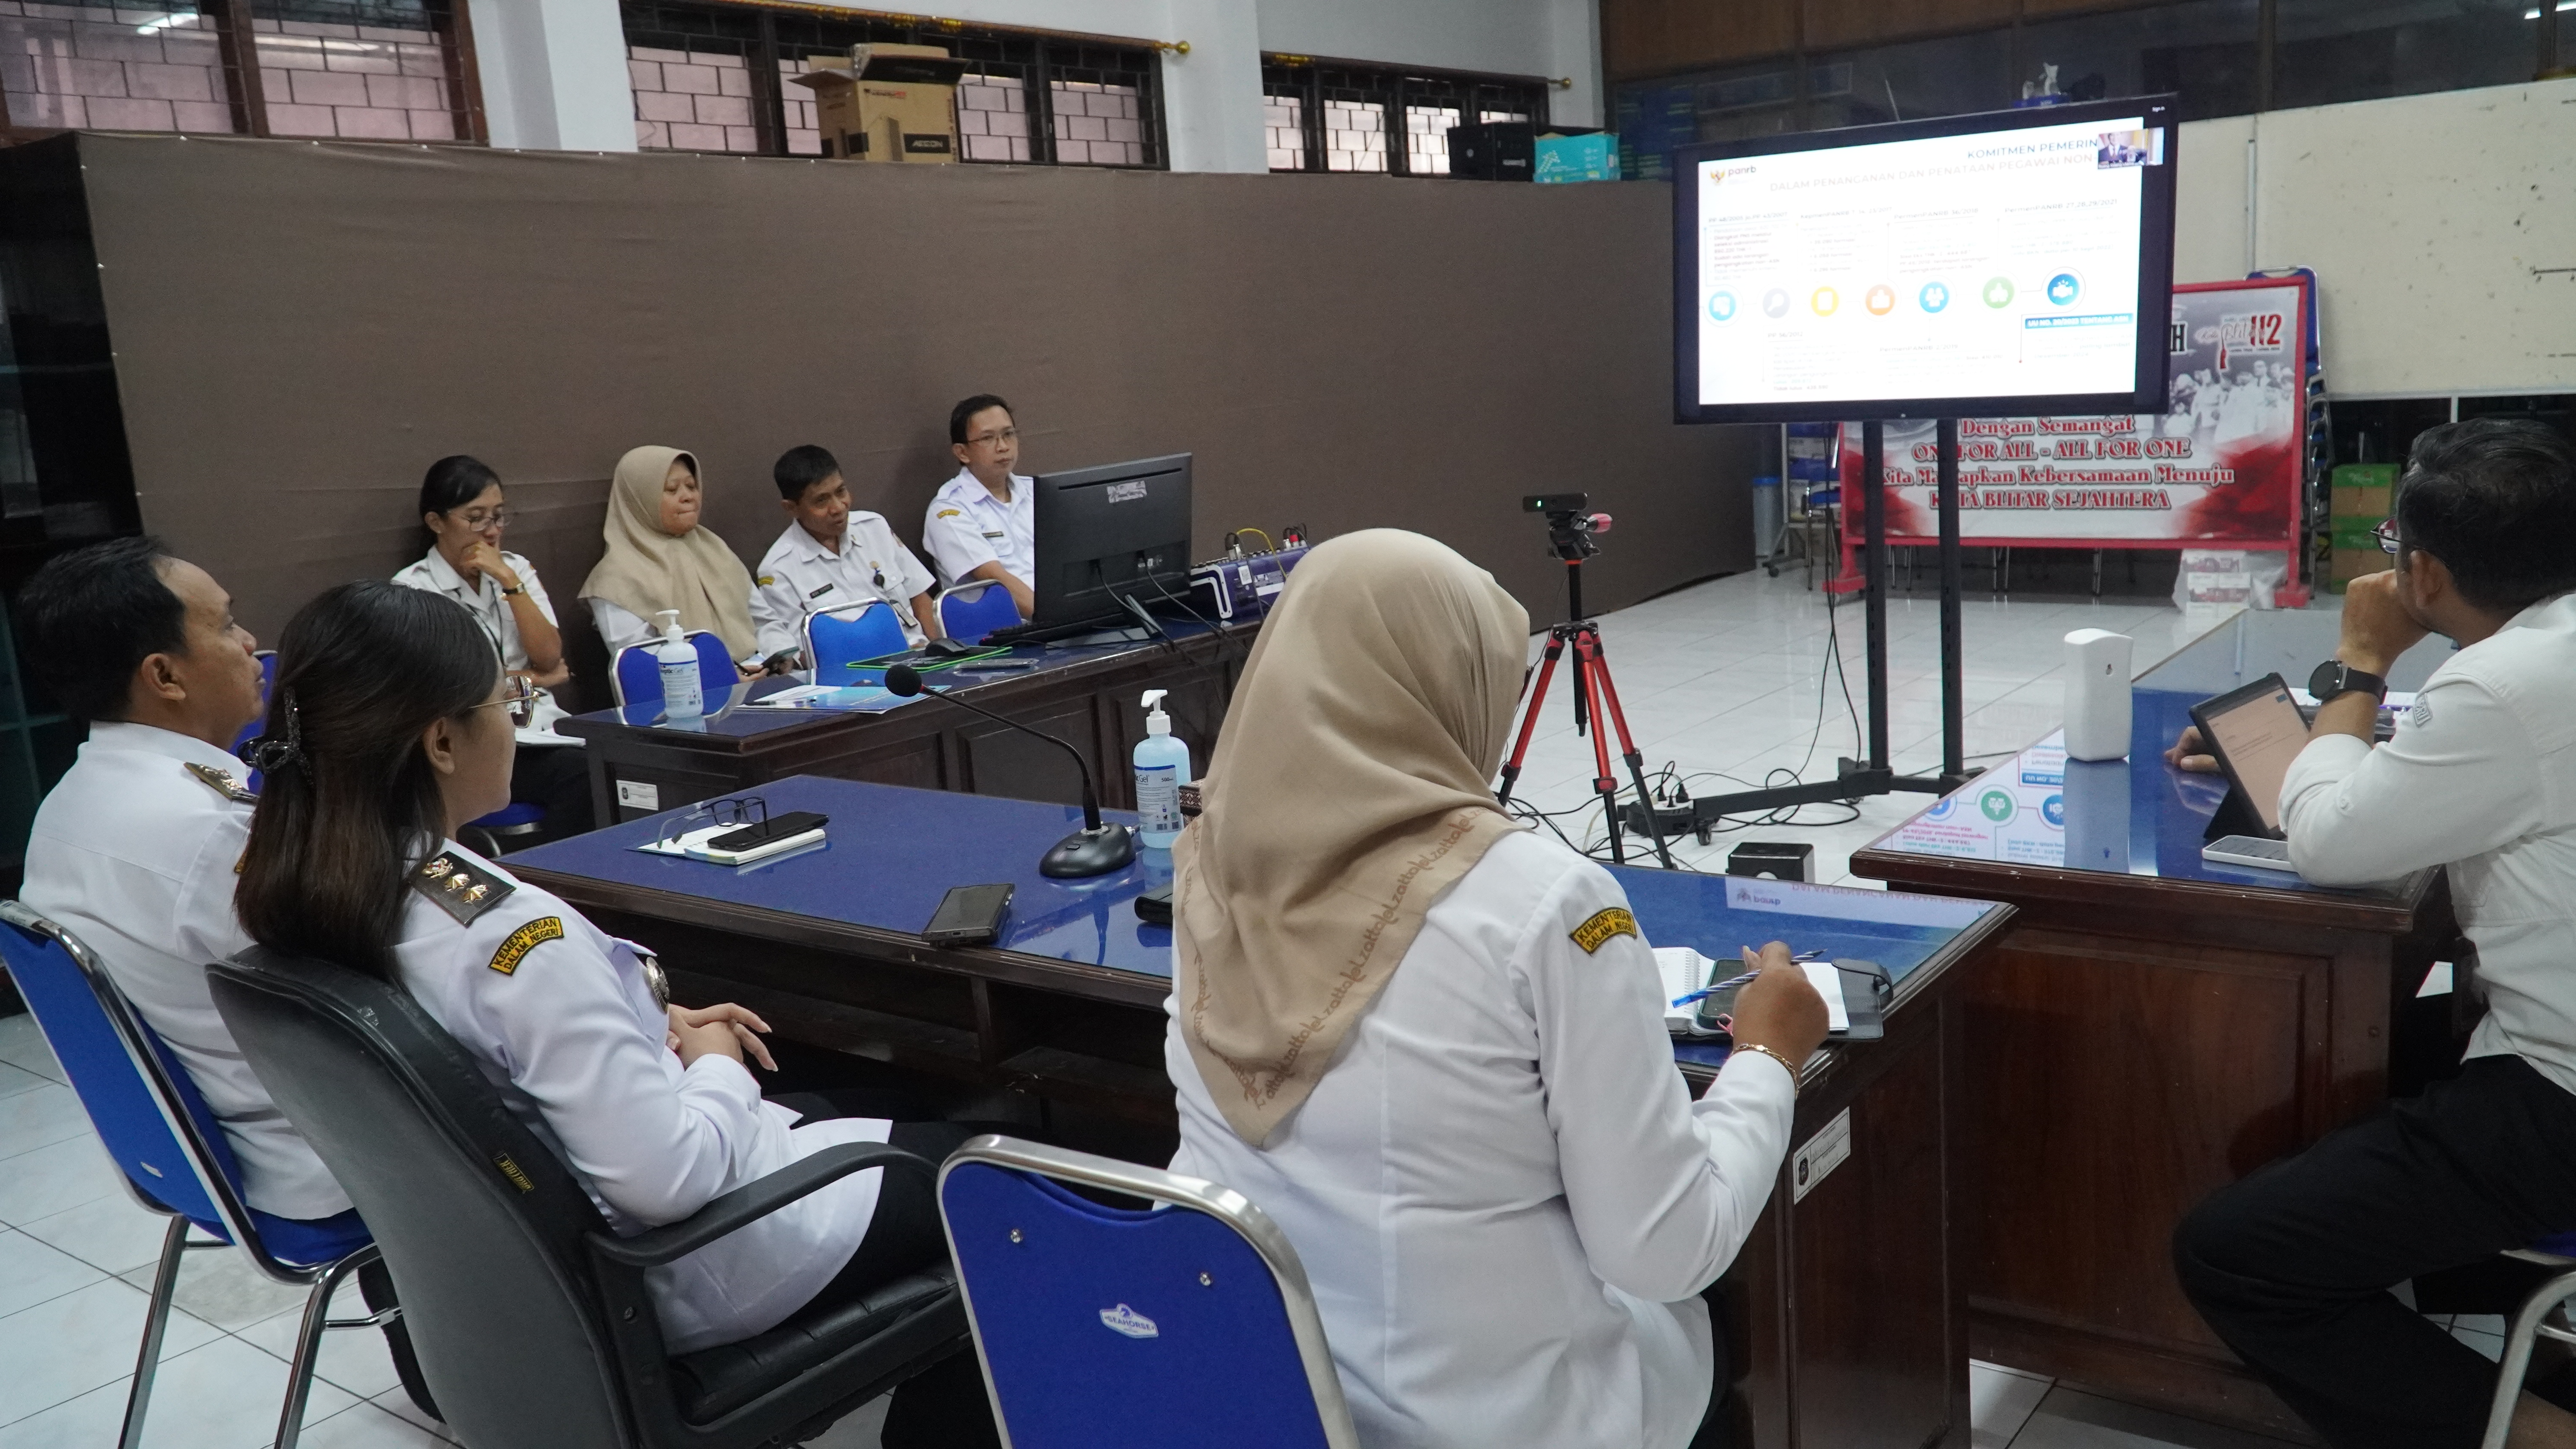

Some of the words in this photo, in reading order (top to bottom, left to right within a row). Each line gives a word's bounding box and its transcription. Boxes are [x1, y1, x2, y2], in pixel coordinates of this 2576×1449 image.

[1968, 145, 2035, 159] KOMITMEN
[2040, 139, 2097, 153] PEMERIN
[1728, 165, 1756, 176] panrb
[1770, 180, 1810, 192] DALAM
[1814, 172, 1895, 188] PENANGANAN
[1899, 168, 1924, 180] DAN
[1929, 163, 1995, 177] PENATAAN
[1999, 158, 2060, 170] PEGAWAI
[1894, 210, 1948, 219] PermenPANRB
[2005, 203, 2063, 212] PermenPANRB
[1961, 418, 2034, 439] Dengan
[2038, 414, 2135, 437] Semangat
[2001, 440, 2038, 460] ALL
[2054, 439, 2093, 459] ALL
[2095, 438, 2142, 459] FOR
[2145, 437, 2192, 458] ONE
[2018, 465, 2151, 485] Kebersamaan
[2154, 463, 2235, 487] Menuju
[1984, 489, 2050, 509] BLITAR
[2052, 489, 2172, 509] SEJAHTERA
[1139, 774, 1148, 783] Gel
[1577, 909, 1632, 941] KEMENTERIAN
[1586, 924, 1614, 949] DALAM
[1615, 921, 1634, 933] NEGERI
[494, 918, 557, 966] KEMENTERIAN
[504, 941, 530, 970] DALAM
[530, 928, 559, 943] NEGERI
[1108, 1316, 1152, 1331] SEAHORSE
